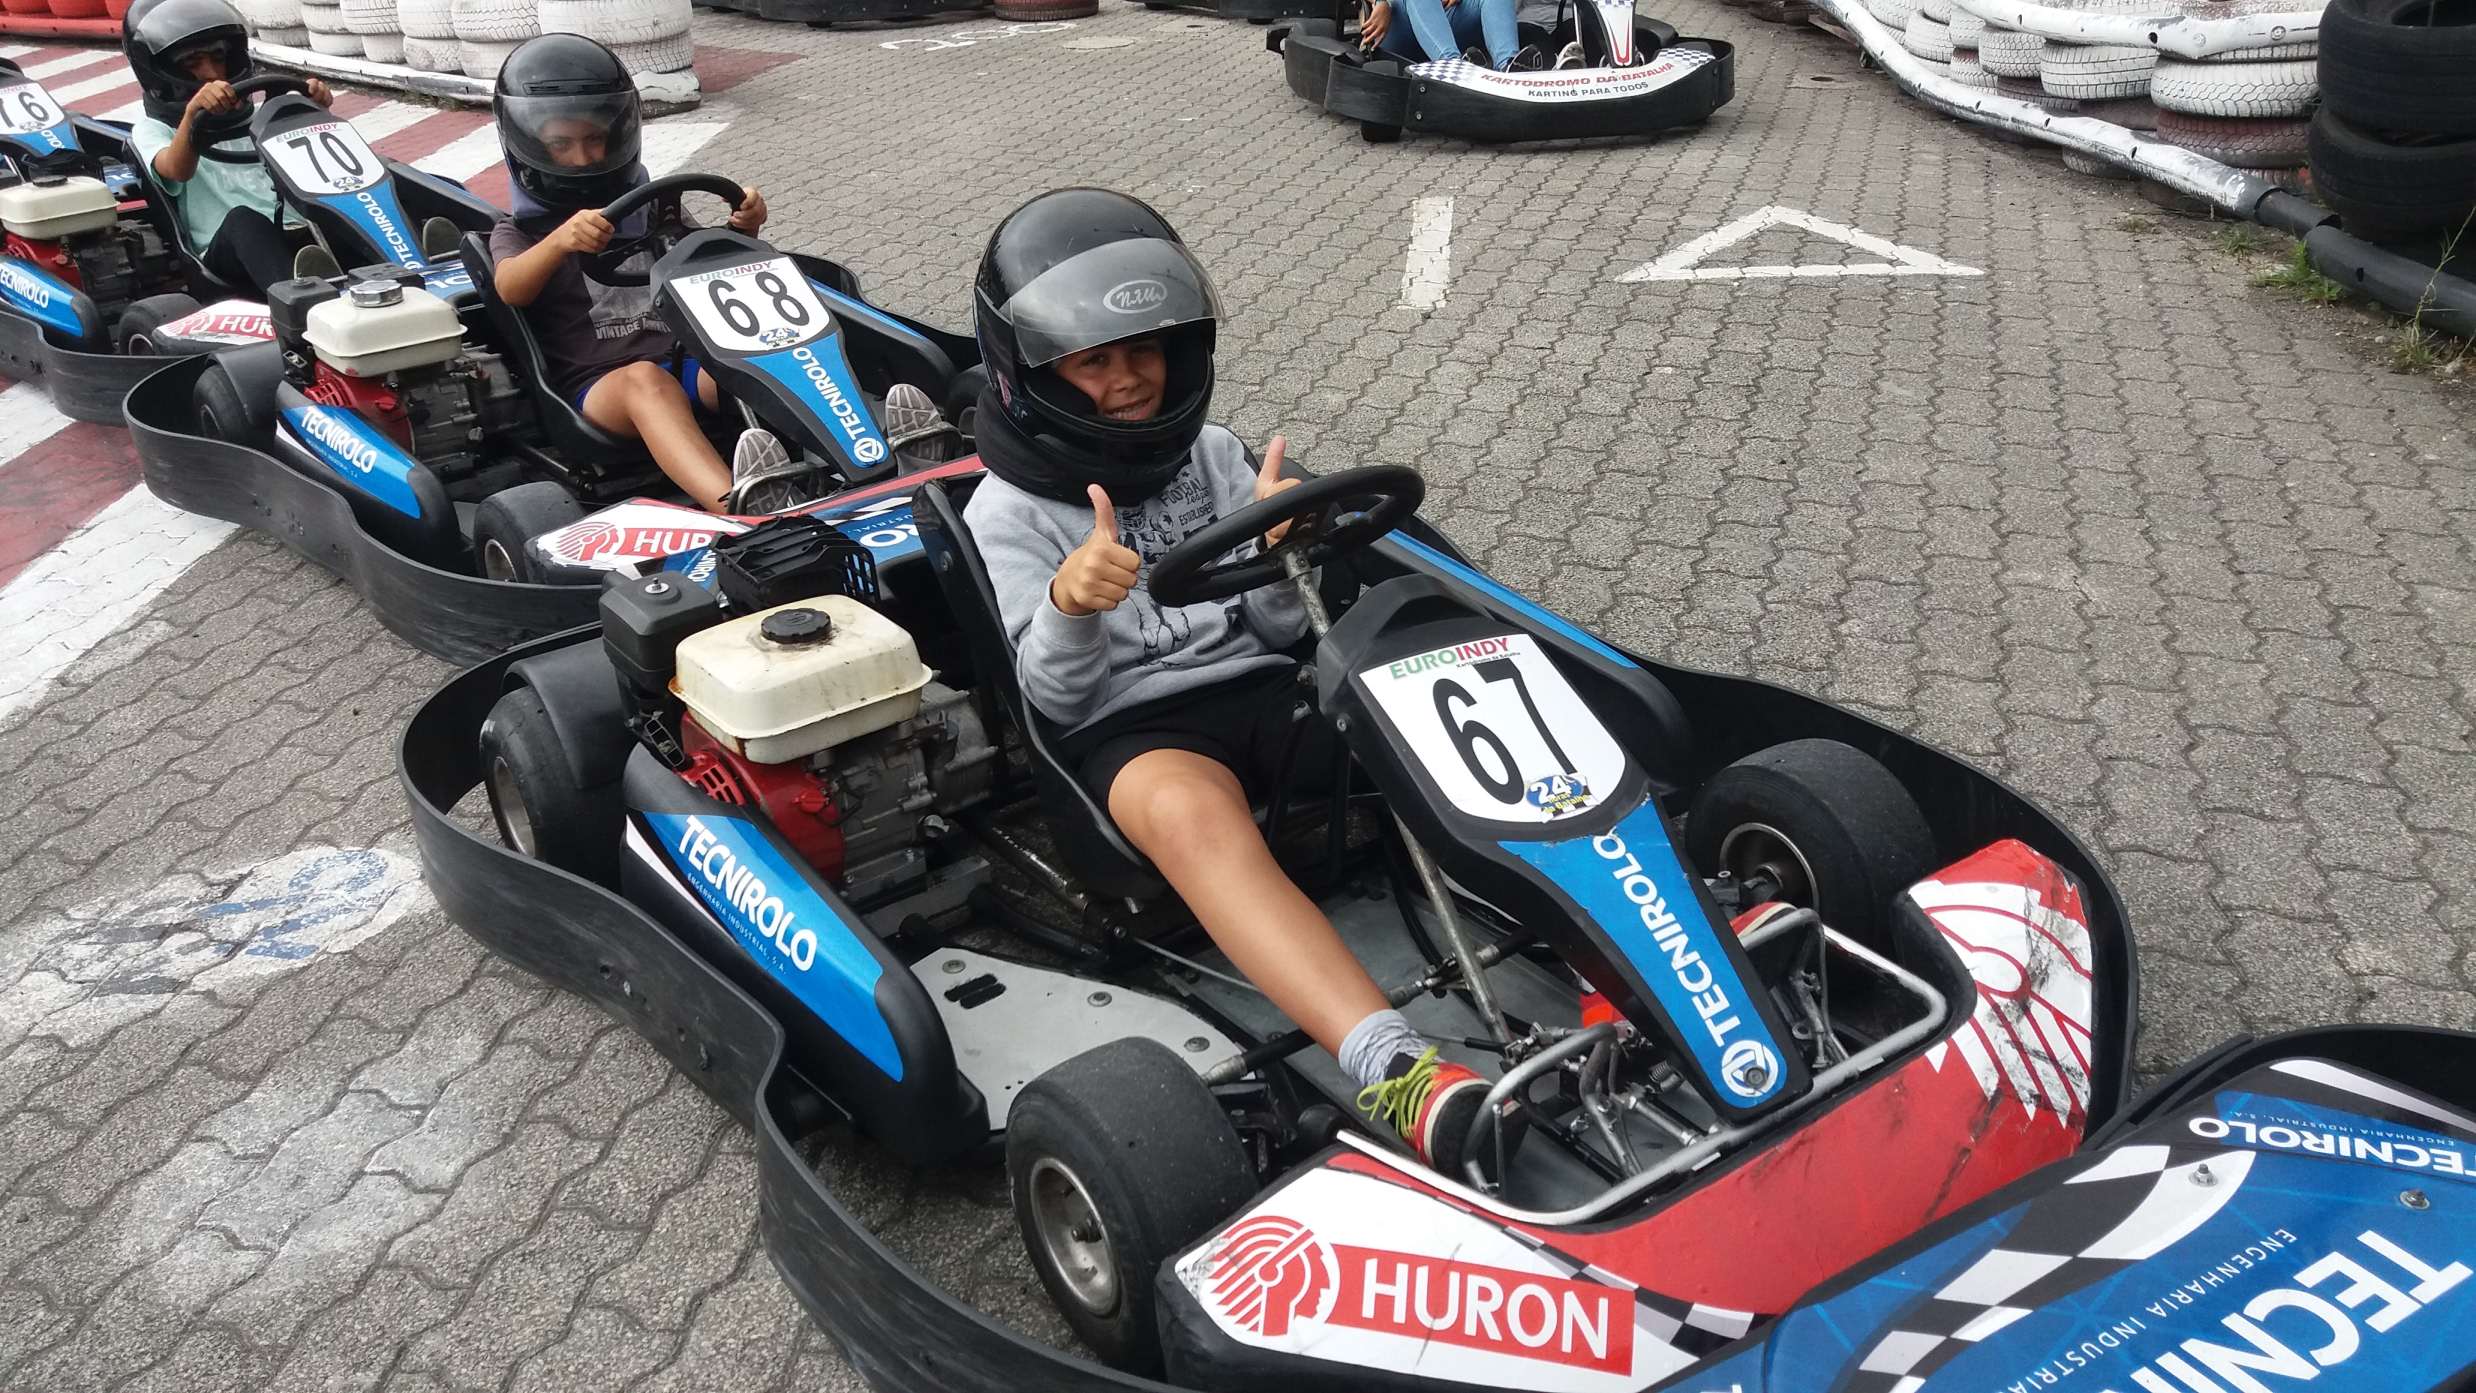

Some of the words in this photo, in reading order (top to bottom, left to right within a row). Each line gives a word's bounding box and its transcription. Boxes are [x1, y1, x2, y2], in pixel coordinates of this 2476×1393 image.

[1527, 89, 1578, 98] KARTING
[1581, 87, 1611, 96] PARA
[1613, 82, 1649, 93] TODOS
[1596, 75, 1618, 83] DA
[1621, 62, 1675, 81] BATALHA
[276, 123, 338, 143] EUROINDY
[286, 131, 364, 184] 70
[357, 192, 414, 262] TECNIROLO
[690, 261, 773, 285] EUROINDY
[708, 271, 810, 337] 68
[793, 347, 866, 441] TECNIROLO
[301, 407, 377, 473] TECNIROLO
[1389, 637, 1509, 679] EUROINDY
[1432, 657, 1578, 805] 67
[1530, 776, 1572, 804] 24
[679, 815, 818, 972] TECNIROLO
[687, 872, 728, 917] ENGENHARIA
[728, 913, 772, 961] INDUSTRIAL,
[1593, 830, 1741, 1048] TECNIROLO
[2360, 1128, 2455, 1147] ENGENHARIA
[2146, 1228, 2298, 1319] ENGENHARIA
[1362, 1258, 1609, 1360] HURON
[2001, 1316, 2147, 1393] INDUSTRIA
